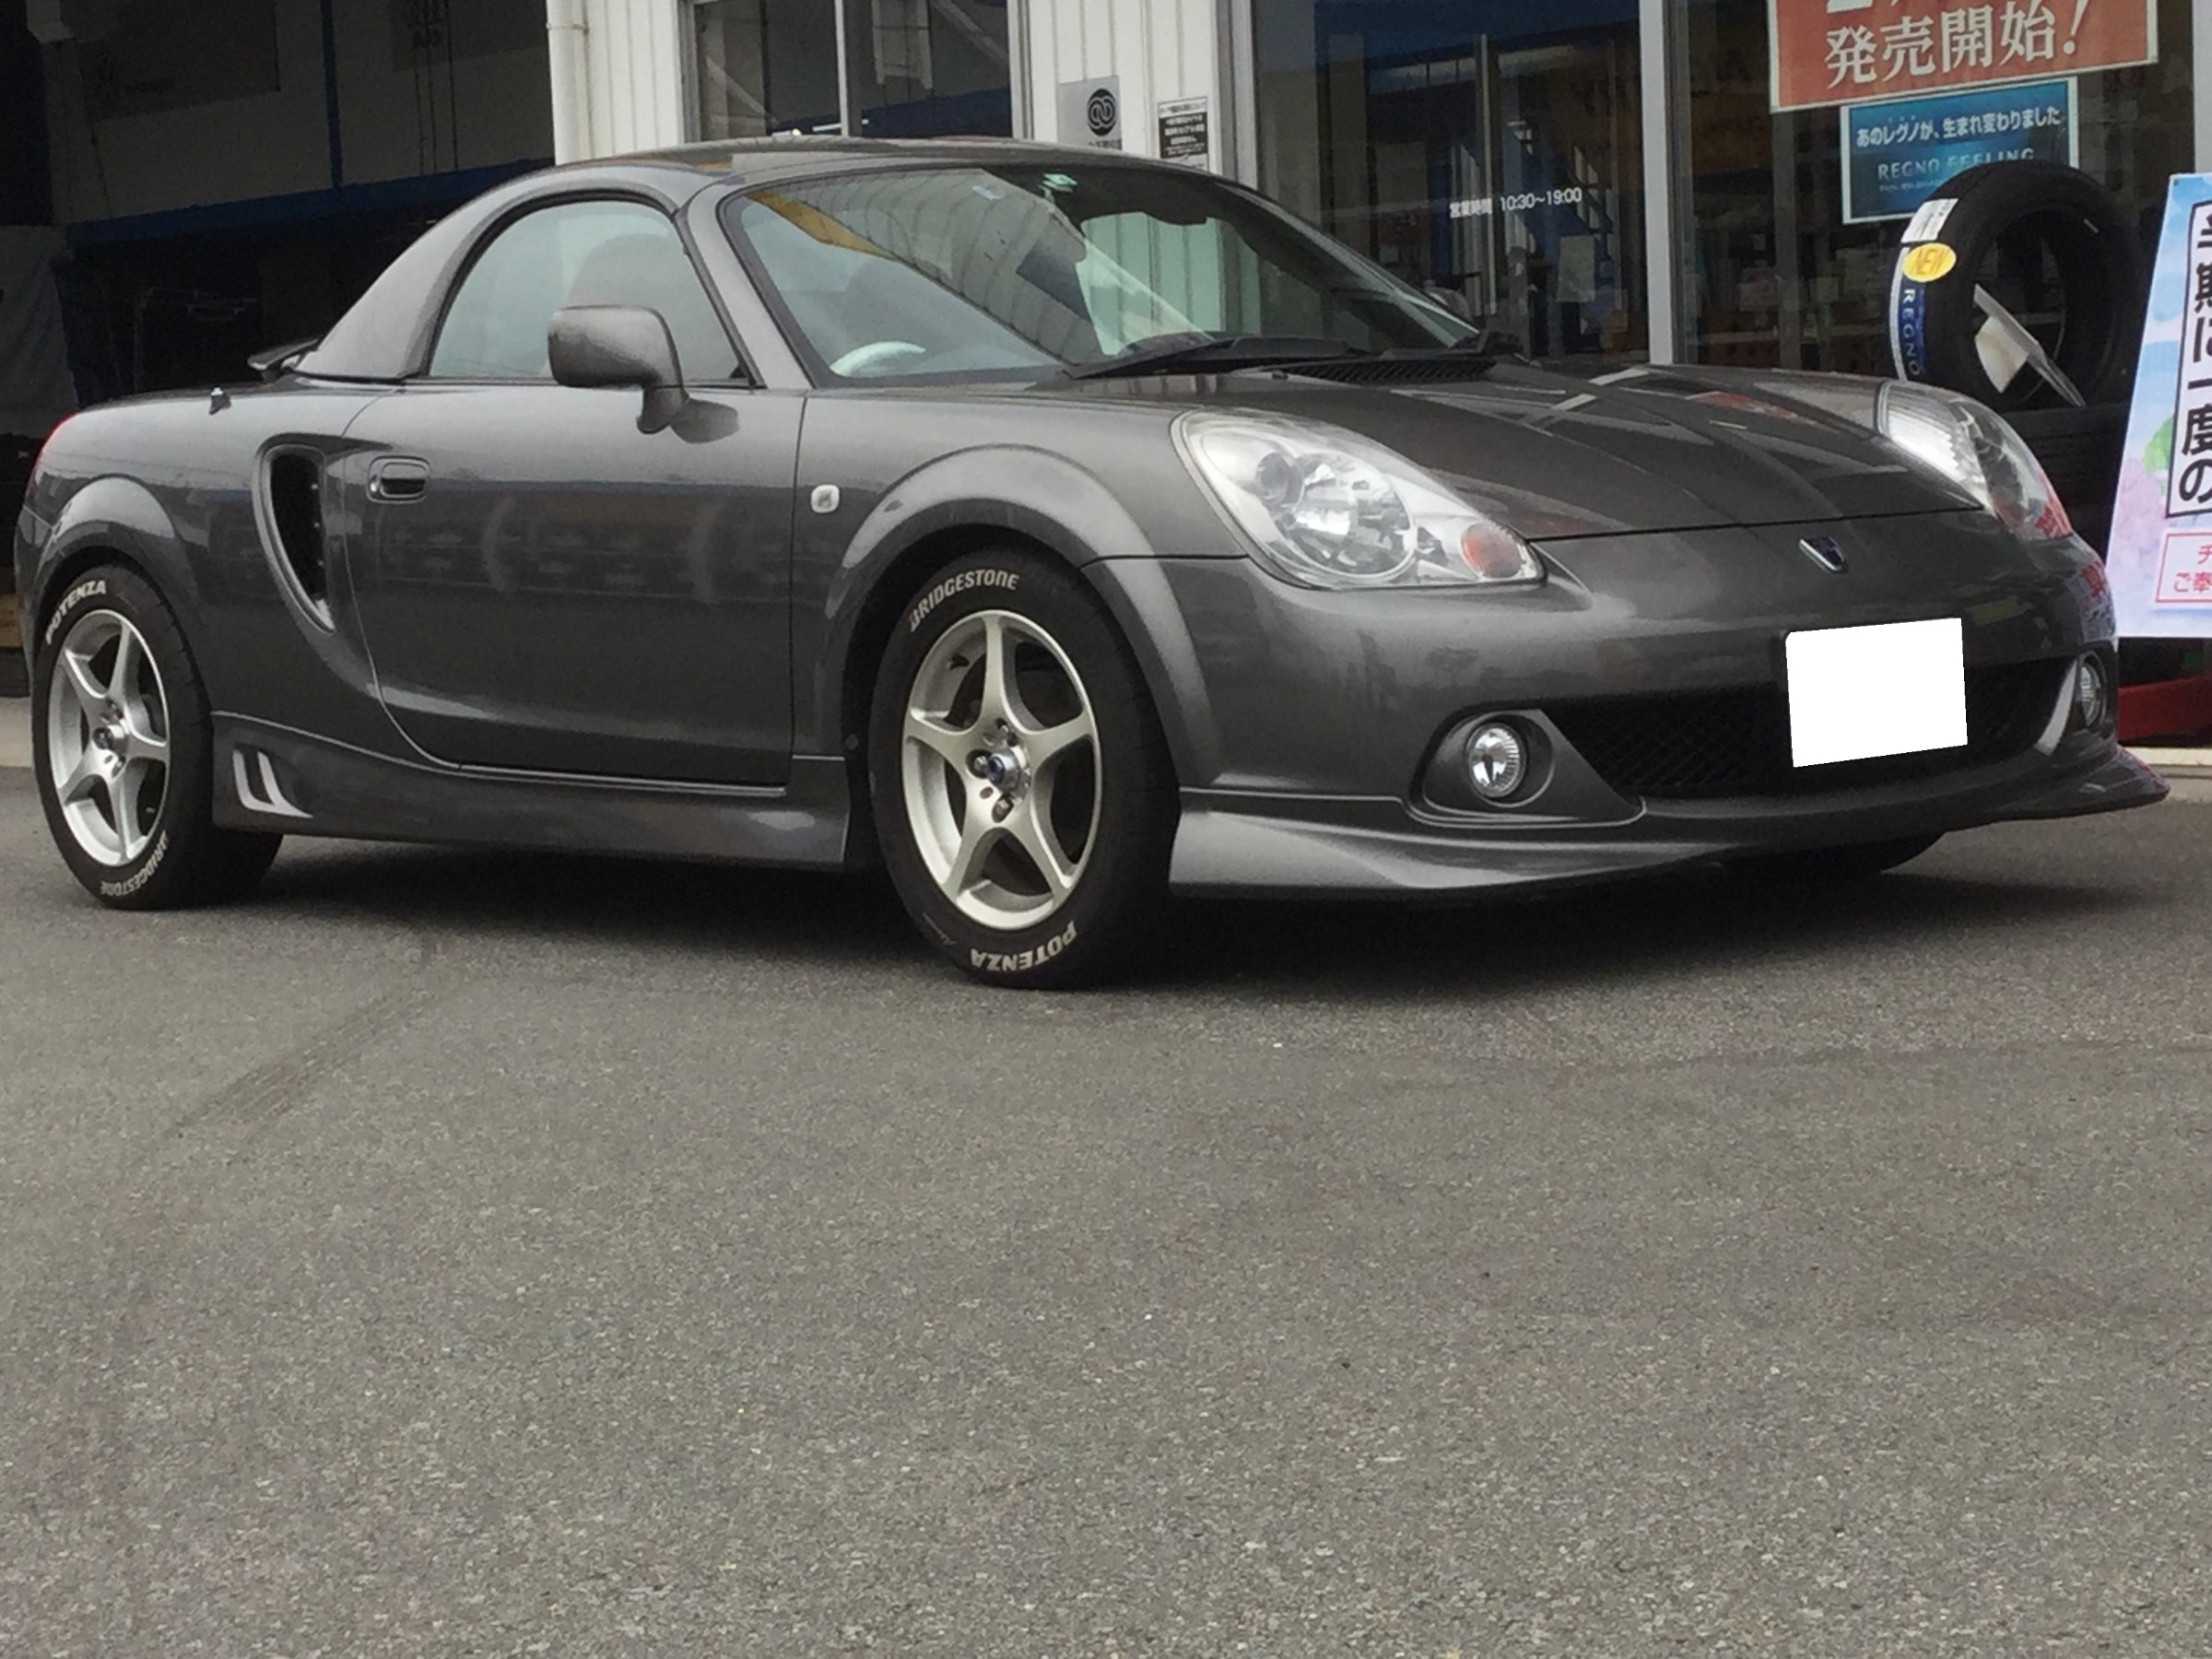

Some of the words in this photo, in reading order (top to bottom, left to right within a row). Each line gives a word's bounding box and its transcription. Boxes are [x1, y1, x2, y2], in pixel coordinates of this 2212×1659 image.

[1824, 0, 2088, 89] 発売開始!
[1856, 106, 2062, 147] あのレグノが、生まれ変わりました
[1877, 159, 1940, 181] REGNO
[1902, 288, 1923, 376] REGNO
[45, 580, 107, 645] POTENZA
[908, 568, 1020, 633] BRIDGESTONE
[970, 920, 1077, 972] POTENZA
